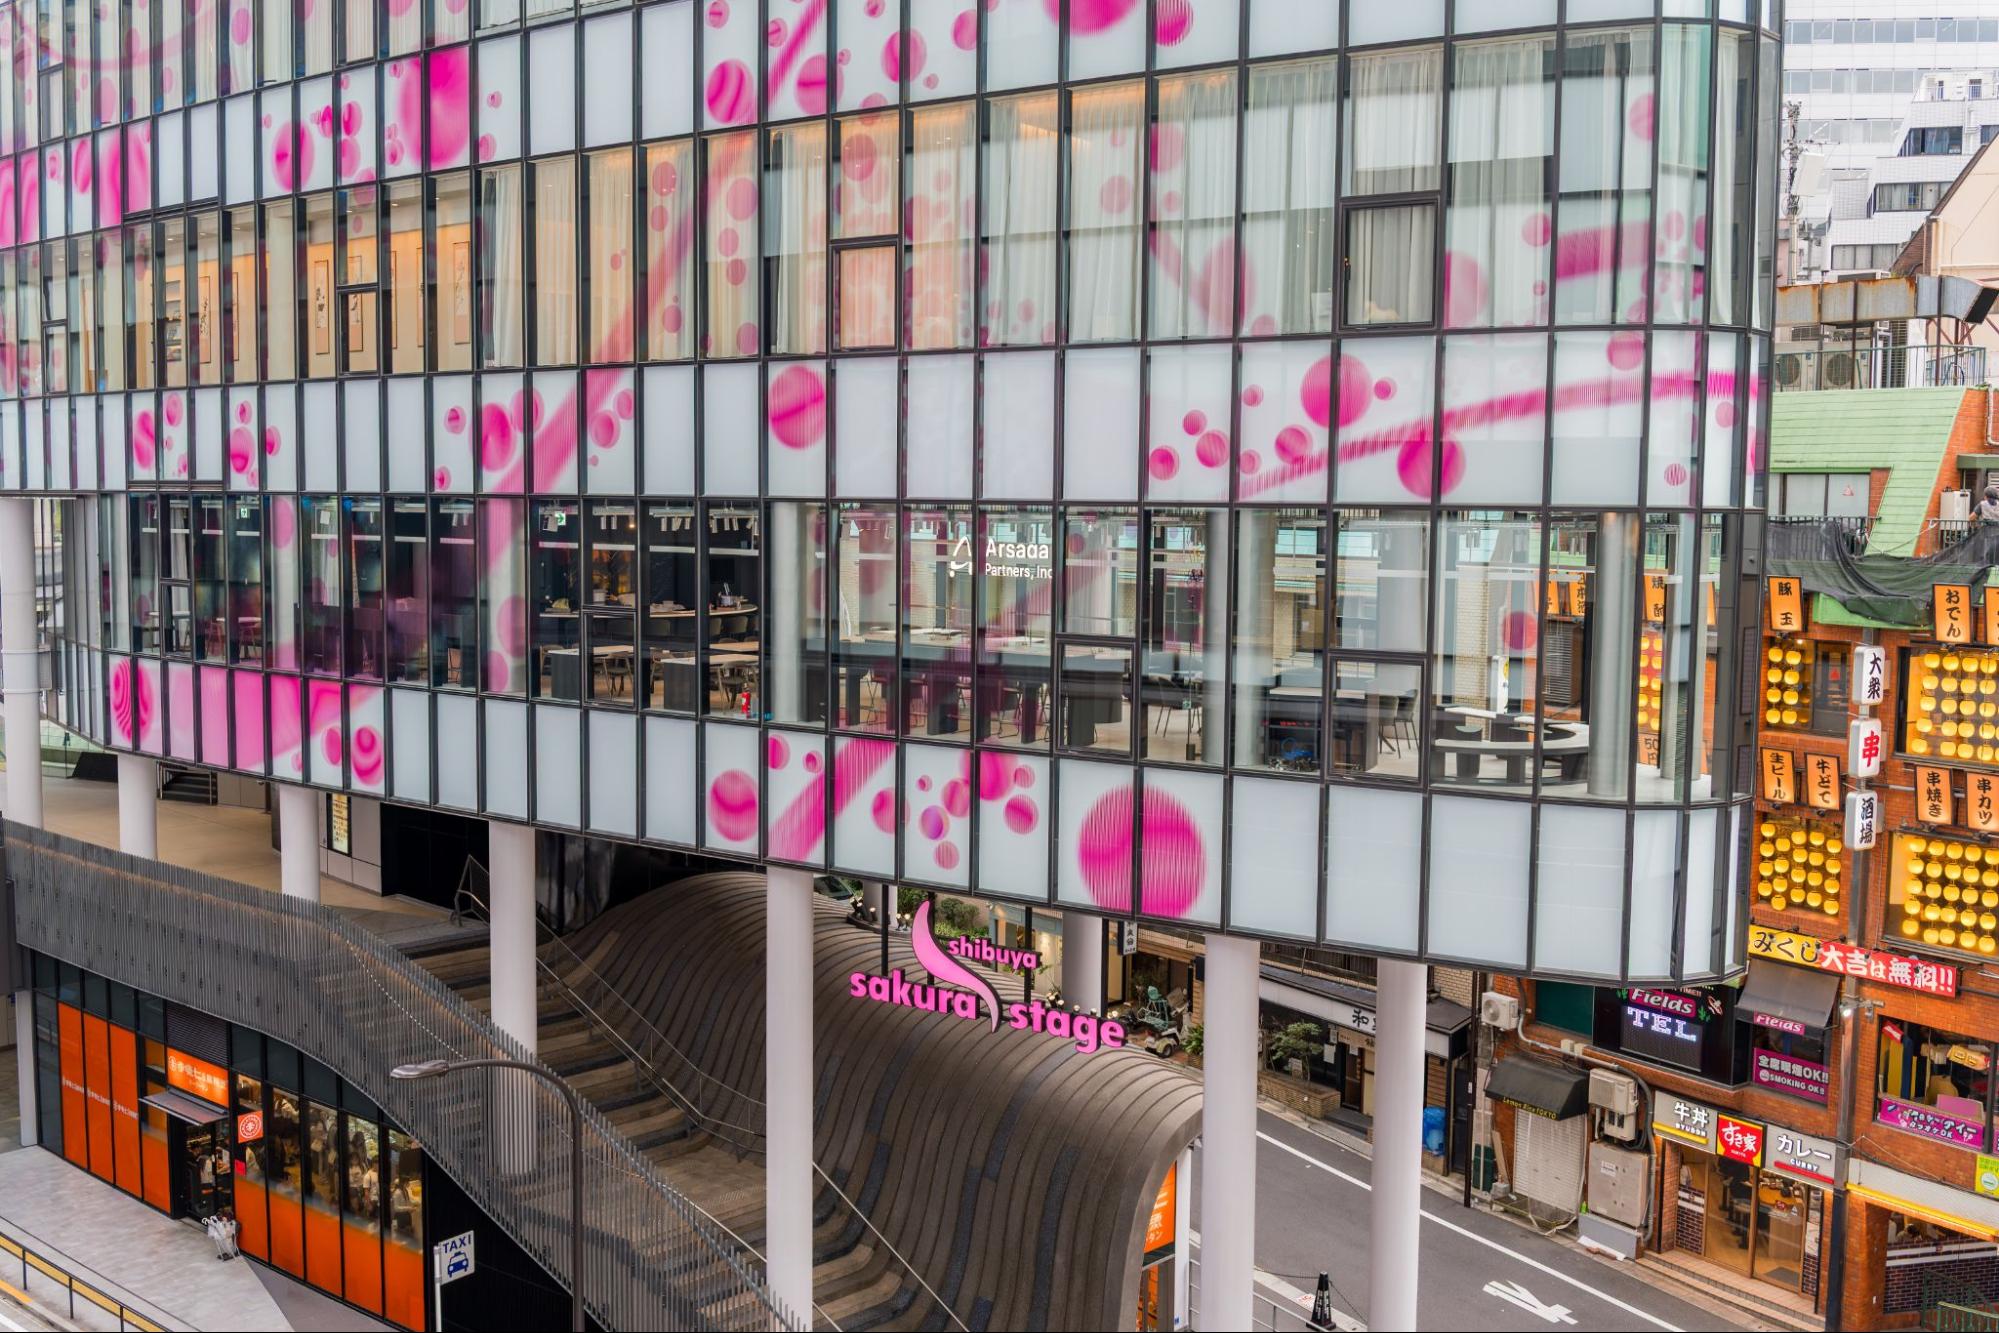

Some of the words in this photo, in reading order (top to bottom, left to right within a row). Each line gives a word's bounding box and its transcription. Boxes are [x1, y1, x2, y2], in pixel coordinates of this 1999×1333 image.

[985, 565, 1034, 580] Partners,
[1778, 581, 1793, 626] 豚玉
[1945, 589, 1961, 638] おでん
[1867, 652, 1882, 700] 大衆
[1862, 731, 1880, 767] 串
[1770, 752, 1786, 799] 生ビール
[1926, 771, 1942, 818] 串焼き
[1977, 778, 1993, 825] 串カツ
[1859, 797, 1875, 844] 酒場
[947, 935, 1041, 970] shibuya
[849, 968, 980, 1021] sakura
[1009, 999, 1127, 1054] stage
[1631, 988, 1694, 1015] Fields
[1627, 1006, 1697, 1042] TEL
[1770, 1074, 1806, 1090] SMOKING
[1674, 1101, 1710, 1128] 牛丼
[1721, 1121, 1758, 1153] すき家
[1777, 1133, 1832, 1161] カレー
[1790, 1158, 1818, 1172] CURRY
[443, 1234, 471, 1254] TAXI
